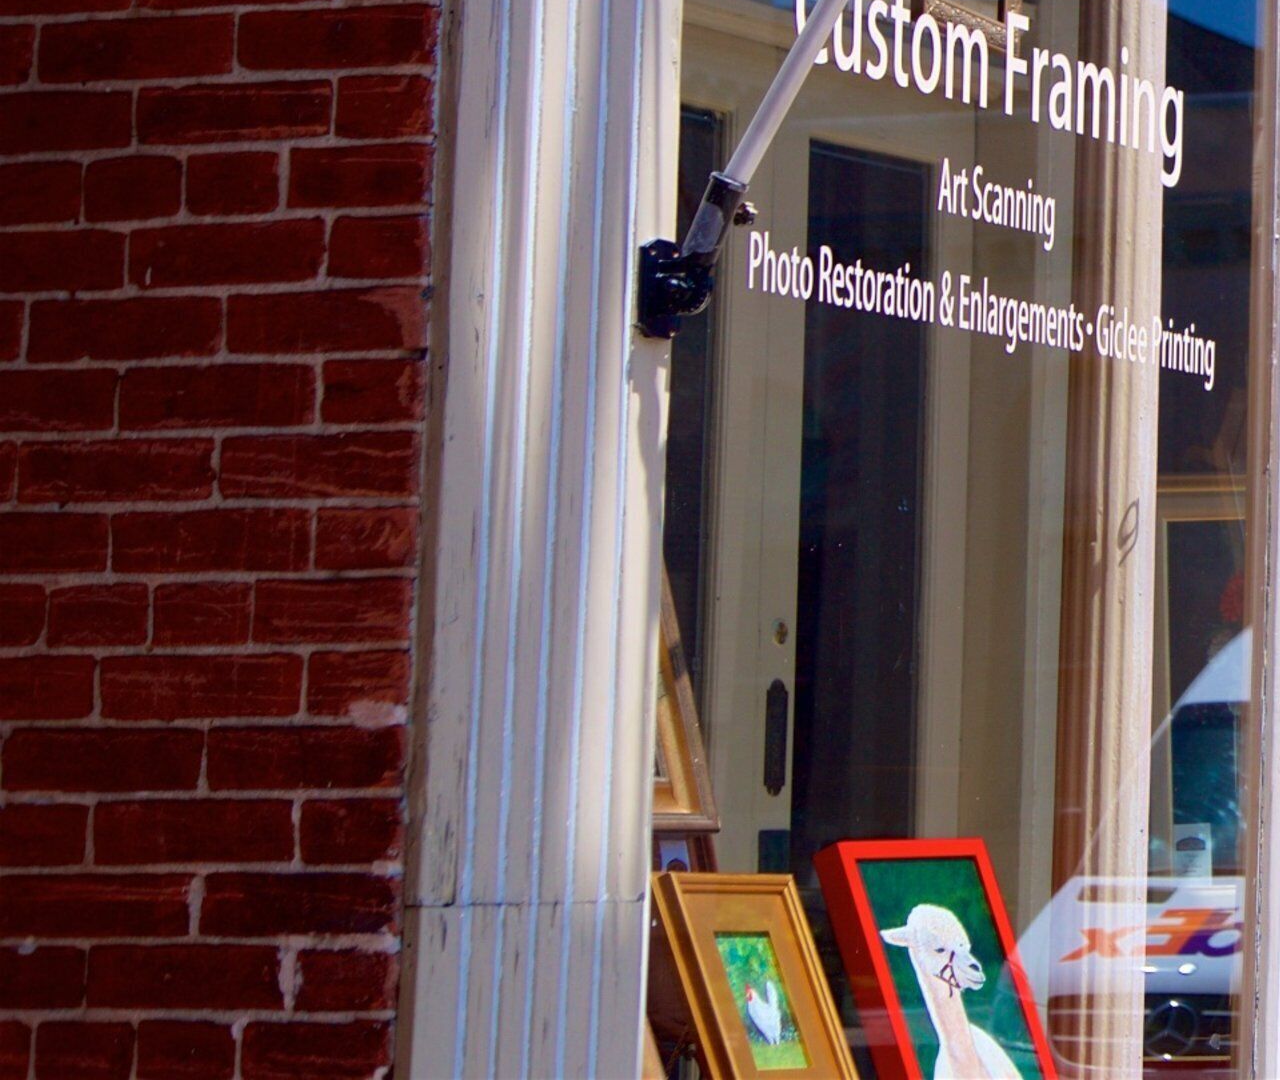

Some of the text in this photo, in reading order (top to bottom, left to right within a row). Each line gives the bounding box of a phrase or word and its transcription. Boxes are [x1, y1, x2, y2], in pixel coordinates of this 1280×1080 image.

[1004, 11, 1184, 188] Framing
[938, 158, 1056, 252] Art Scanning
[749, 231, 1215, 391] Photo Restoration & Enlargements Giclee Printing
